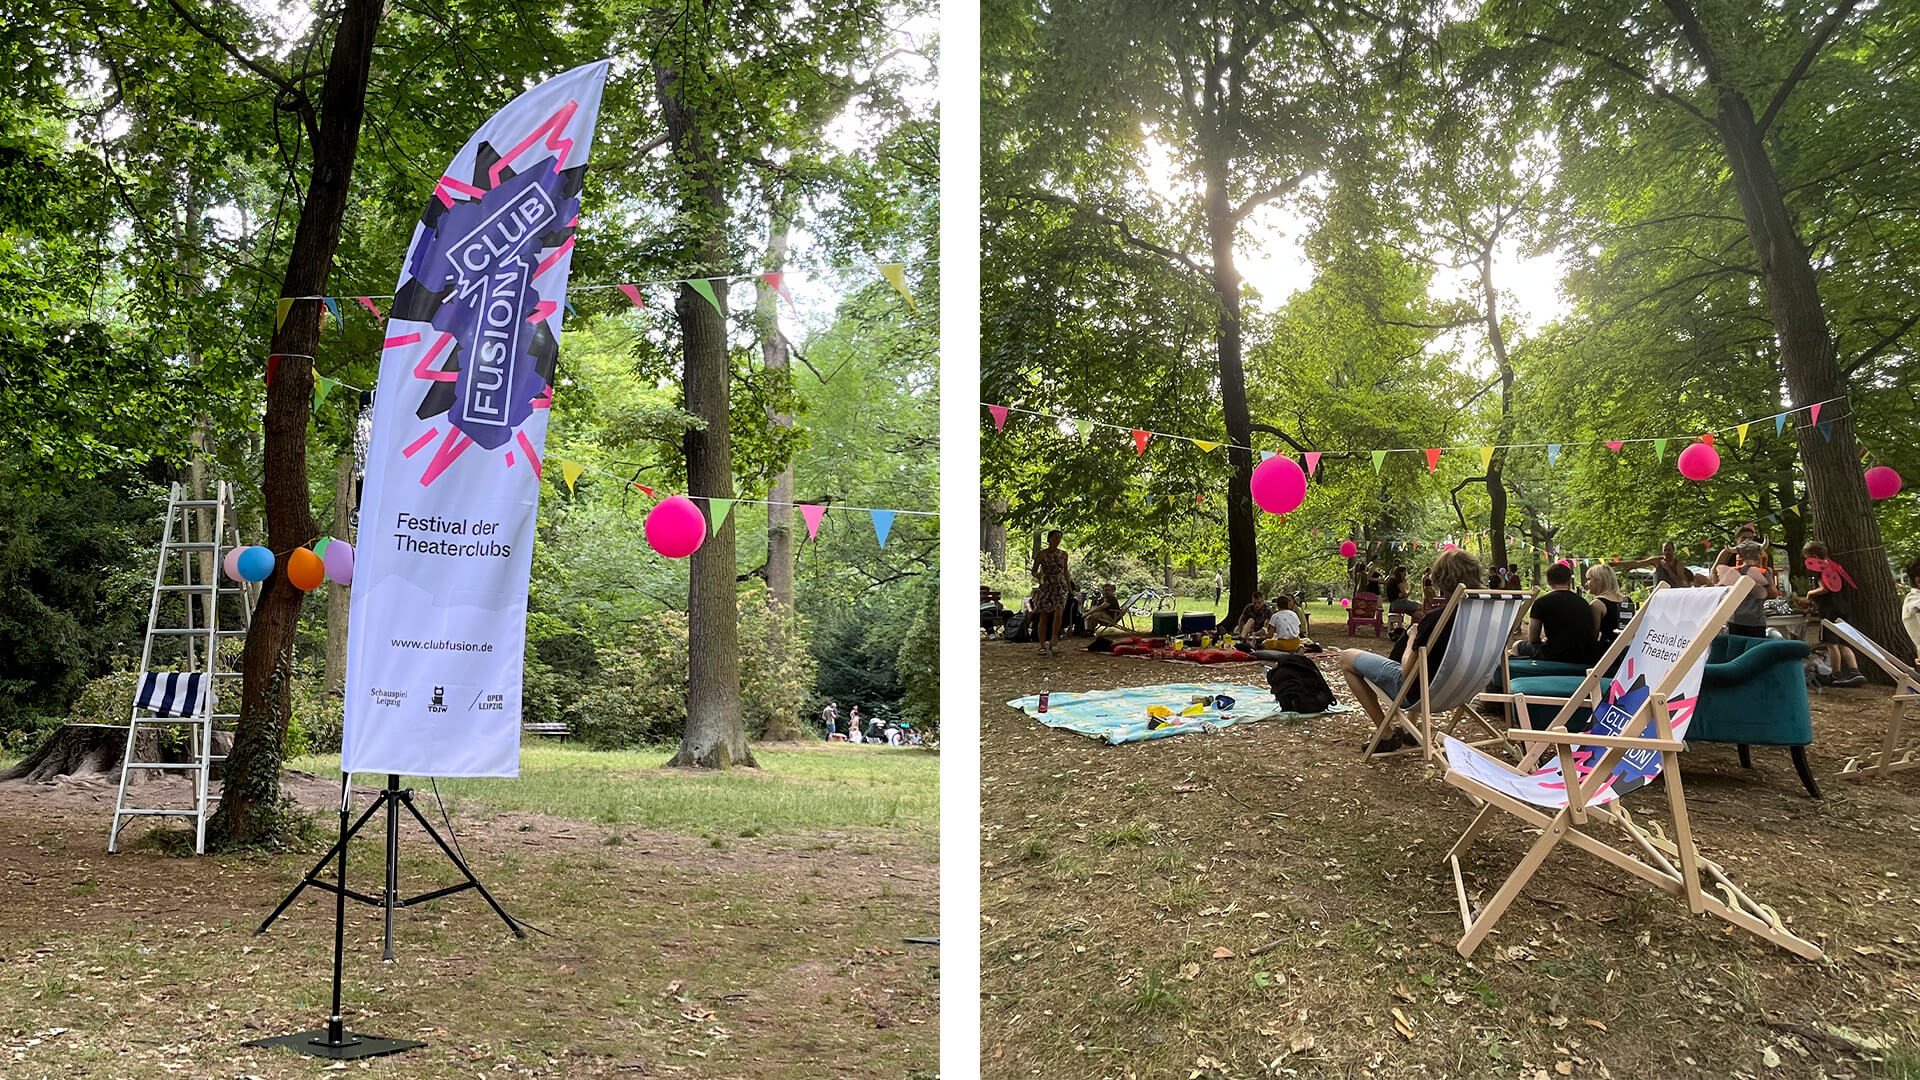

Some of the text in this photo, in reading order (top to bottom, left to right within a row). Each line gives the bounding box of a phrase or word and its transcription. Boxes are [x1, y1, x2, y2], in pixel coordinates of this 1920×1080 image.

[463, 197, 545, 271] CLUB
[474, 271, 519, 415] FUSION
[397, 512, 499, 535] Festival der
[394, 534, 511, 558] Theaterclubs
[391, 639, 493, 653] www.clubfusion.de
[1646, 629, 1677, 647] Festival
[1641, 641, 1680, 663] Theatercl
[370, 687, 408, 699] Schauspiel
[376, 697, 401, 708] Leipzig
[487, 694, 503, 702] OPER
[478, 702, 503, 710] LEIPZIG
[1606, 711, 1630, 731] CLU
